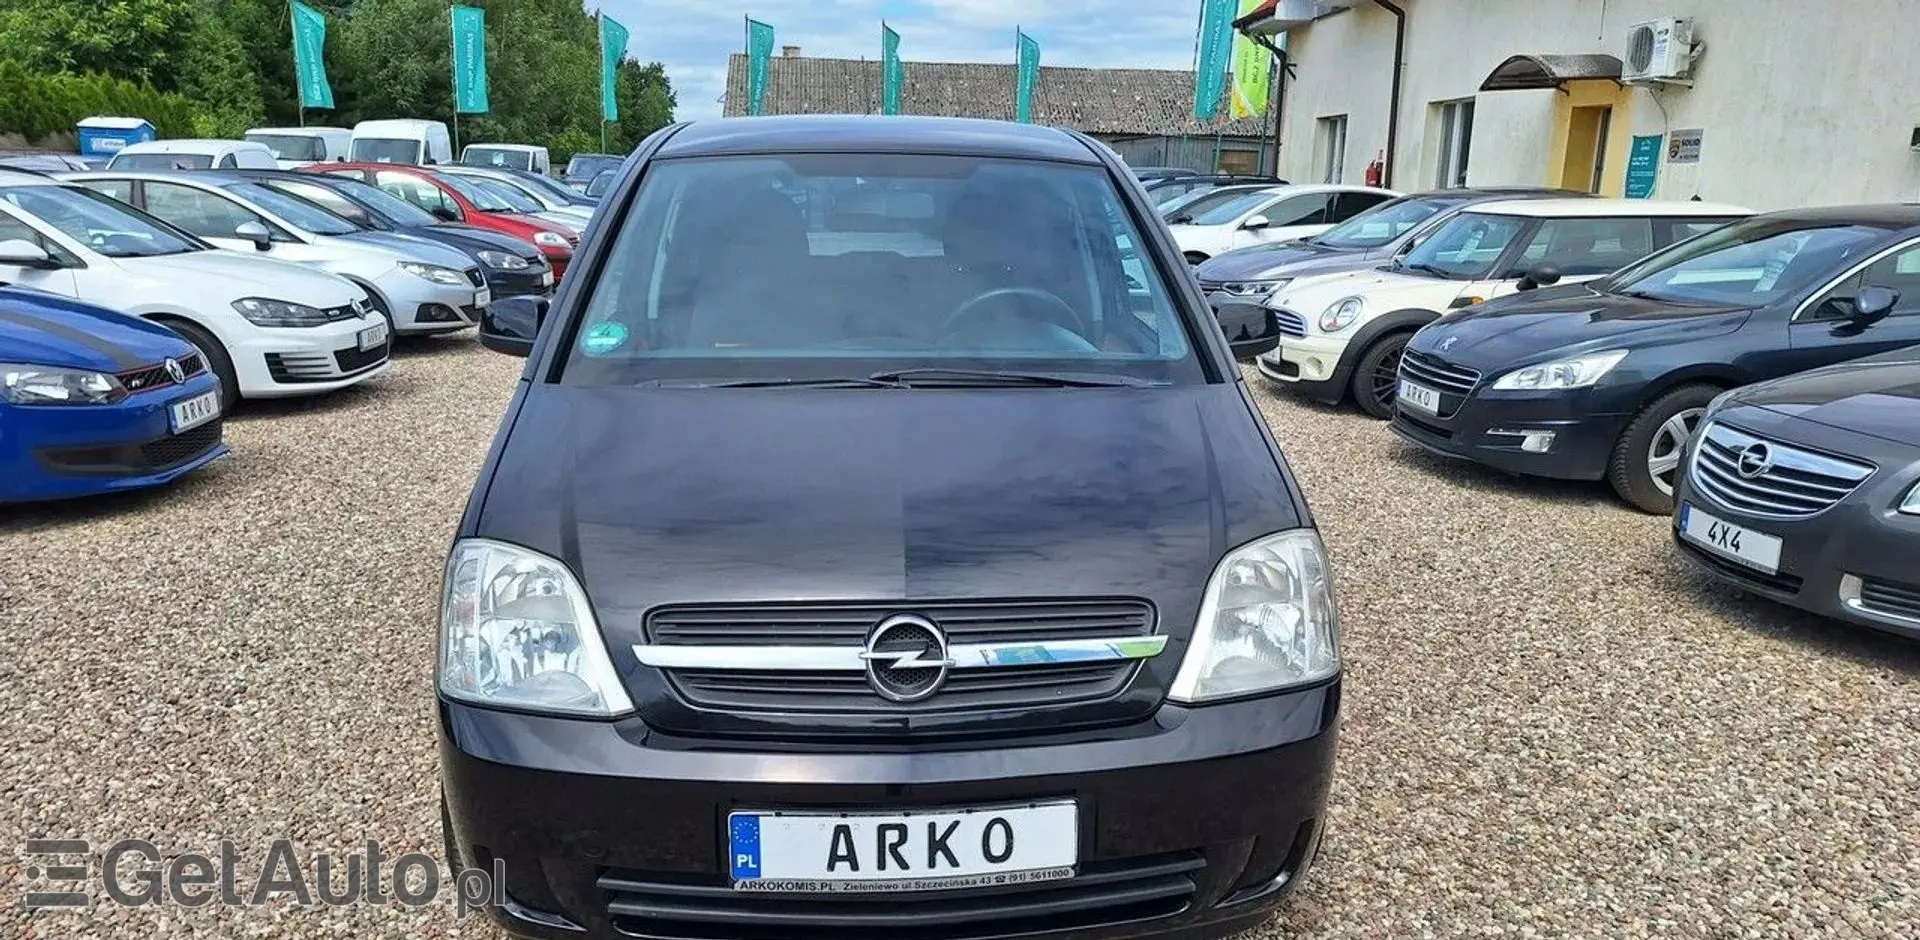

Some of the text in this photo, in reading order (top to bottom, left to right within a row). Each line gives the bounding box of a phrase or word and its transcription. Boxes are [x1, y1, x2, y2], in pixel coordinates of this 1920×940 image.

[181, 396, 212, 423] ARKO
[1708, 521, 1741, 553] 4X4
[736, 817, 1014, 873] PL ARKO
[739, 880, 835, 892] ARKOKOMIS.PL
[843, 882, 899, 891] Zieleniewo
[979, 876, 992, 885] 43
[1030, 868, 1069, 881] 5611000
